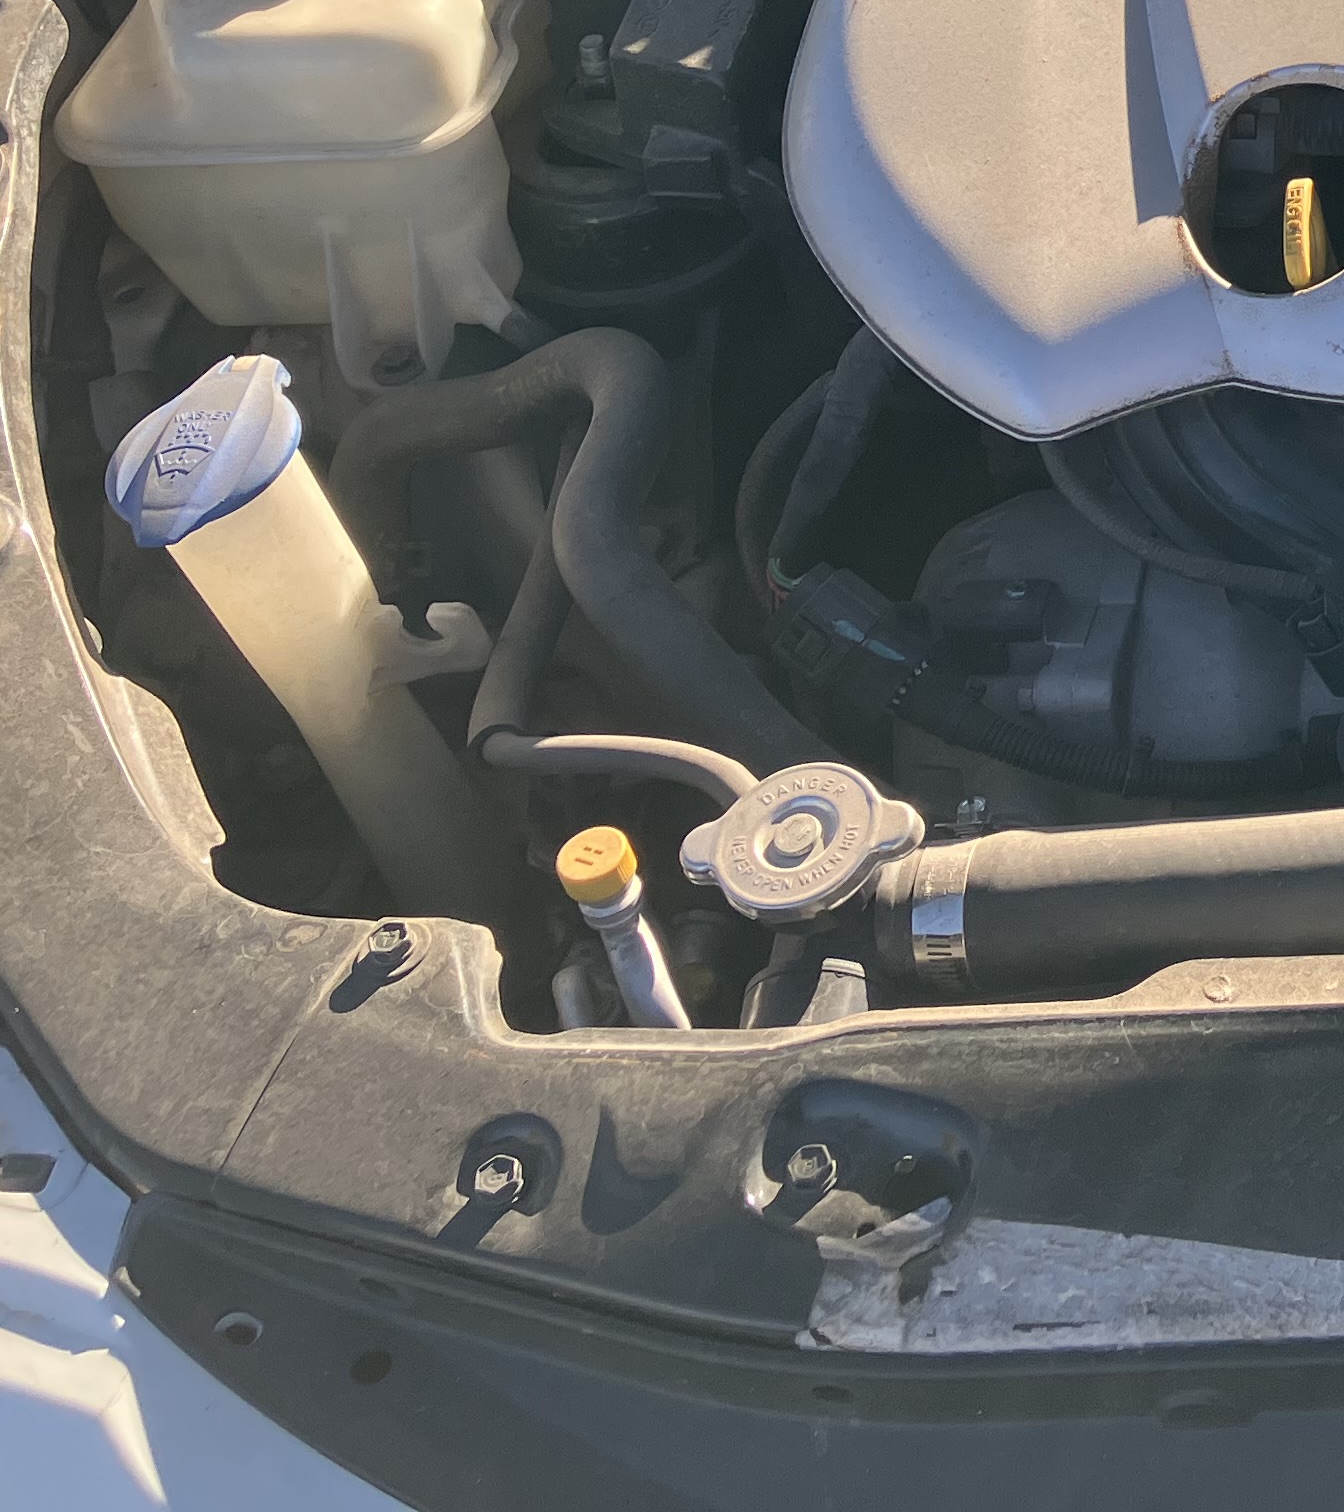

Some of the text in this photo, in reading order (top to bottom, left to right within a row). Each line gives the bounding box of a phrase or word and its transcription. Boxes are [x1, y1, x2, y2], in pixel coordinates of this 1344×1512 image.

[760, 777, 848, 806] DANGER
[730, 835, 755, 880] NEVER
[752, 872, 793, 892] OPEN
[798, 851, 844, 887] WHEN
